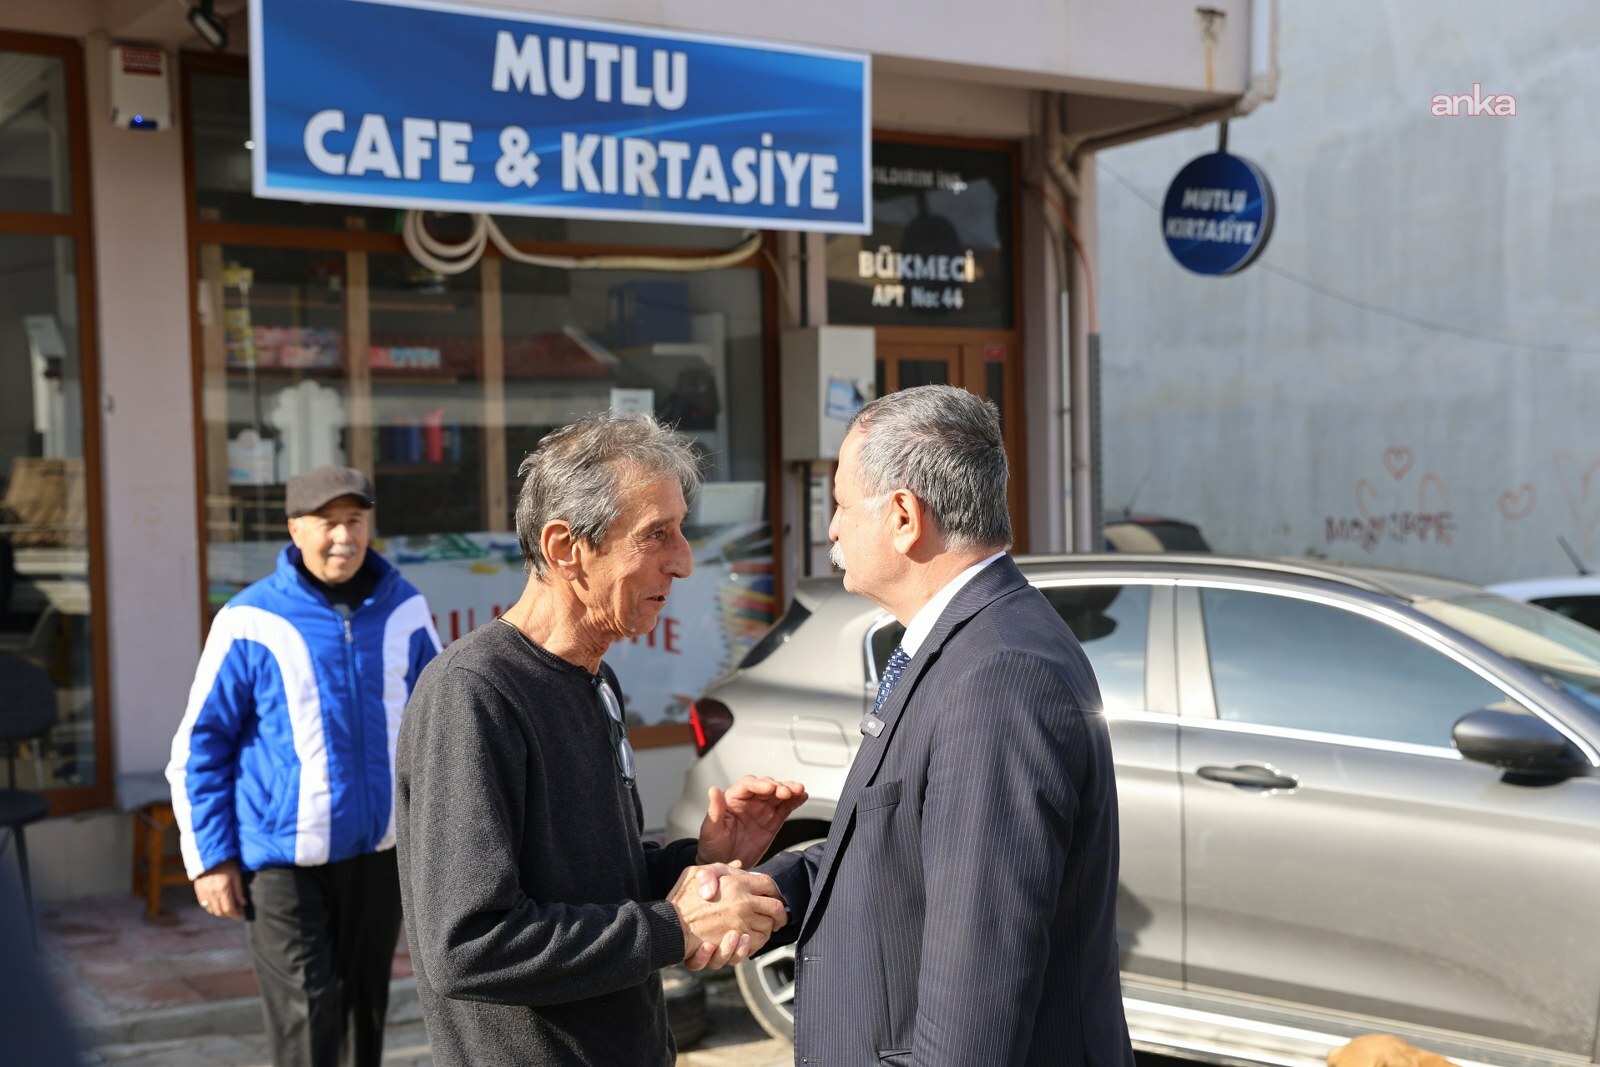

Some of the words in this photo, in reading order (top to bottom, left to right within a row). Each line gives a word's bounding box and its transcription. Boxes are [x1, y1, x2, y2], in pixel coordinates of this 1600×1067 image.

[492, 31, 688, 111] MUTLU
[303, 109, 475, 184] CAFE
[495, 126, 541, 189] &
[561, 132, 839, 210] KIRTASİYE
[1182, 187, 1248, 213] MUTLU
[1166, 215, 1256, 245] KIRTASİYE
[858, 245, 975, 282] BÜKMECİ
